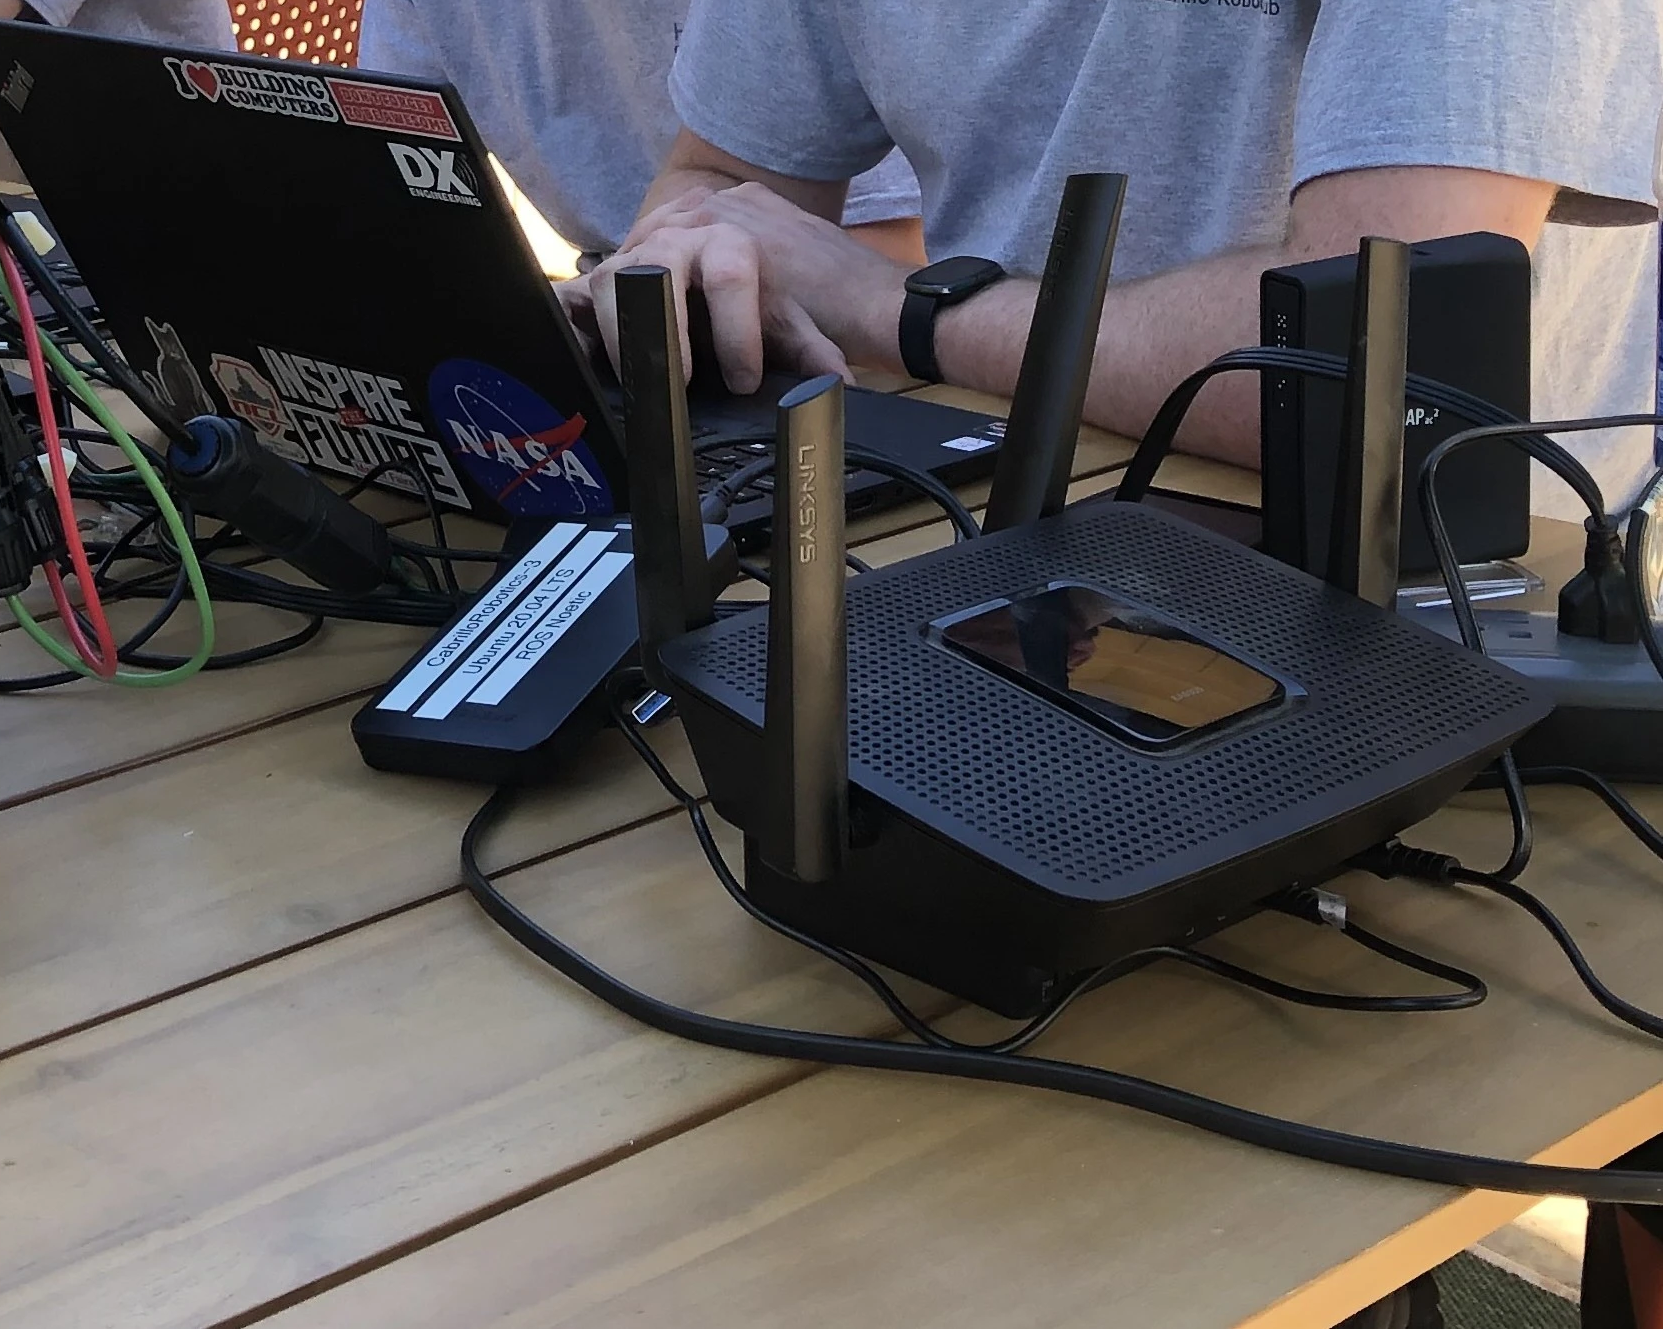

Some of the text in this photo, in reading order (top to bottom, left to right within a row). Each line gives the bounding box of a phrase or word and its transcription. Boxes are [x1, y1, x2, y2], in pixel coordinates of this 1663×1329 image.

[171, 61, 325, 101] I BUILDING
[225, 89, 334, 119] COMPUTERS
[387, 142, 475, 197] DX
[408, 187, 482, 208] ENGINEERING
[257, 346, 425, 433] INSPIRE
[446, 419, 602, 489] NASA
[798, 444, 817, 563] LINKSYS
[427, 560, 542, 667] CabrilloRobotics-3
[463, 568, 575, 674] Ubuntu 20.04 LTS
[515, 590, 593, 661] ROS Noetic
